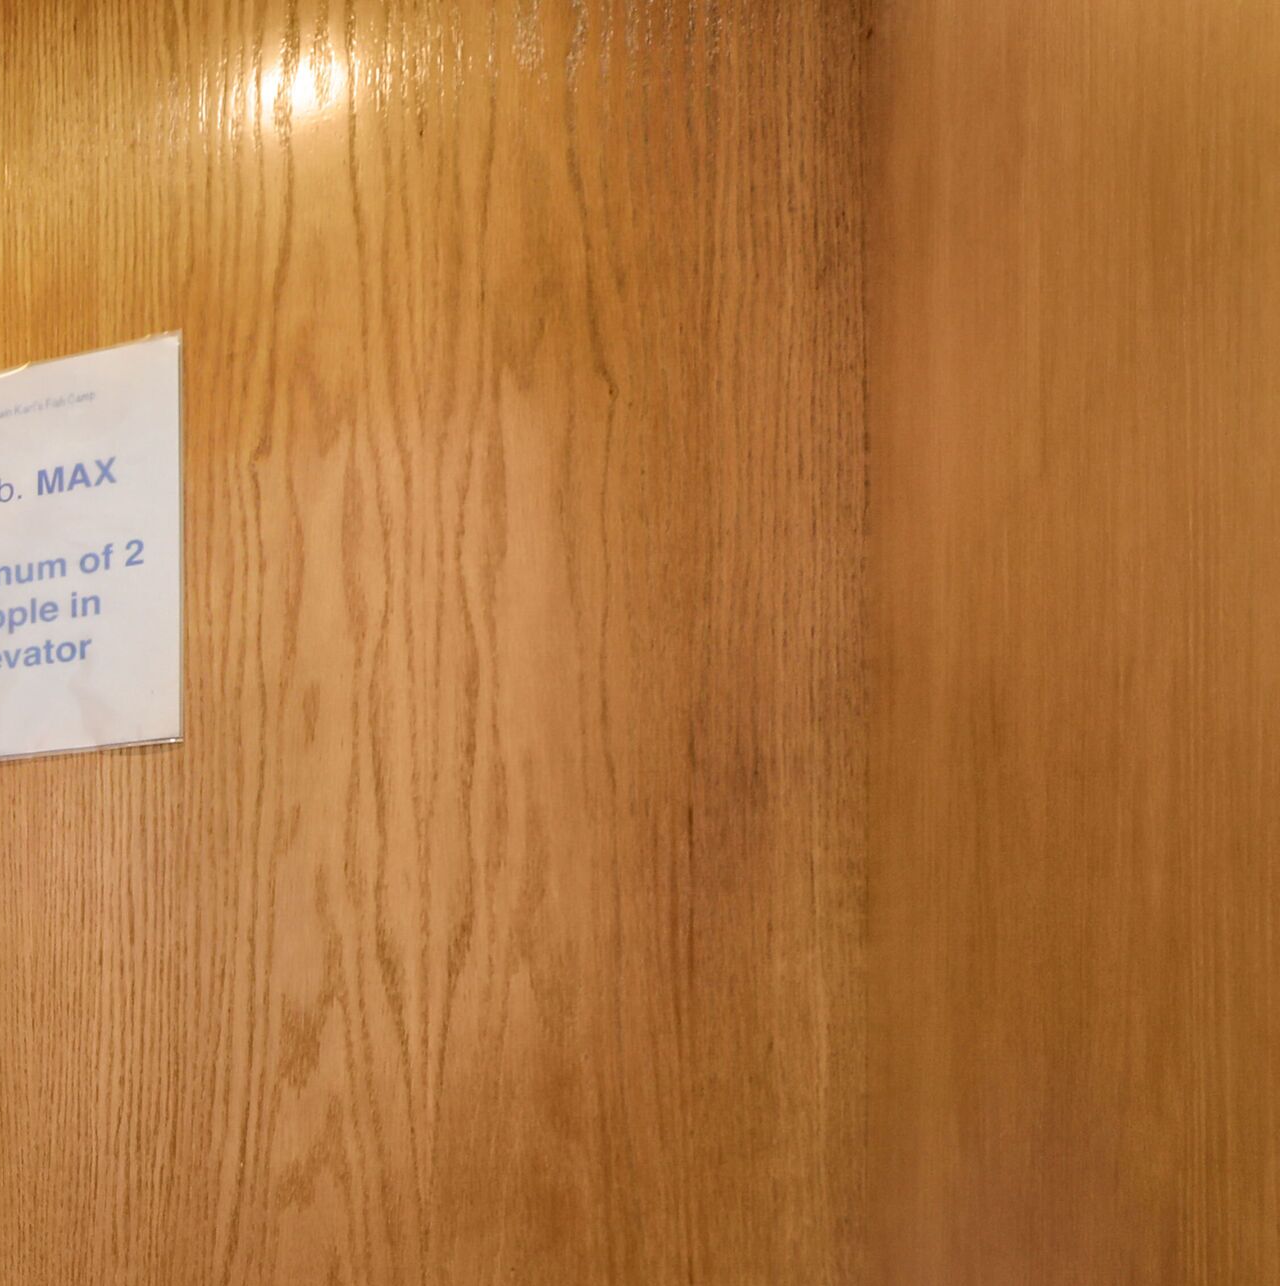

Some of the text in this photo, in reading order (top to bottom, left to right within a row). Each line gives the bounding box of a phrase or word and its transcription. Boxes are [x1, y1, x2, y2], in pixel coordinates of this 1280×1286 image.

[37, 457, 116, 496] MAX
[79, 543, 113, 574] of
[125, 539, 144, 567] 2
[71, 592, 100, 618] in
